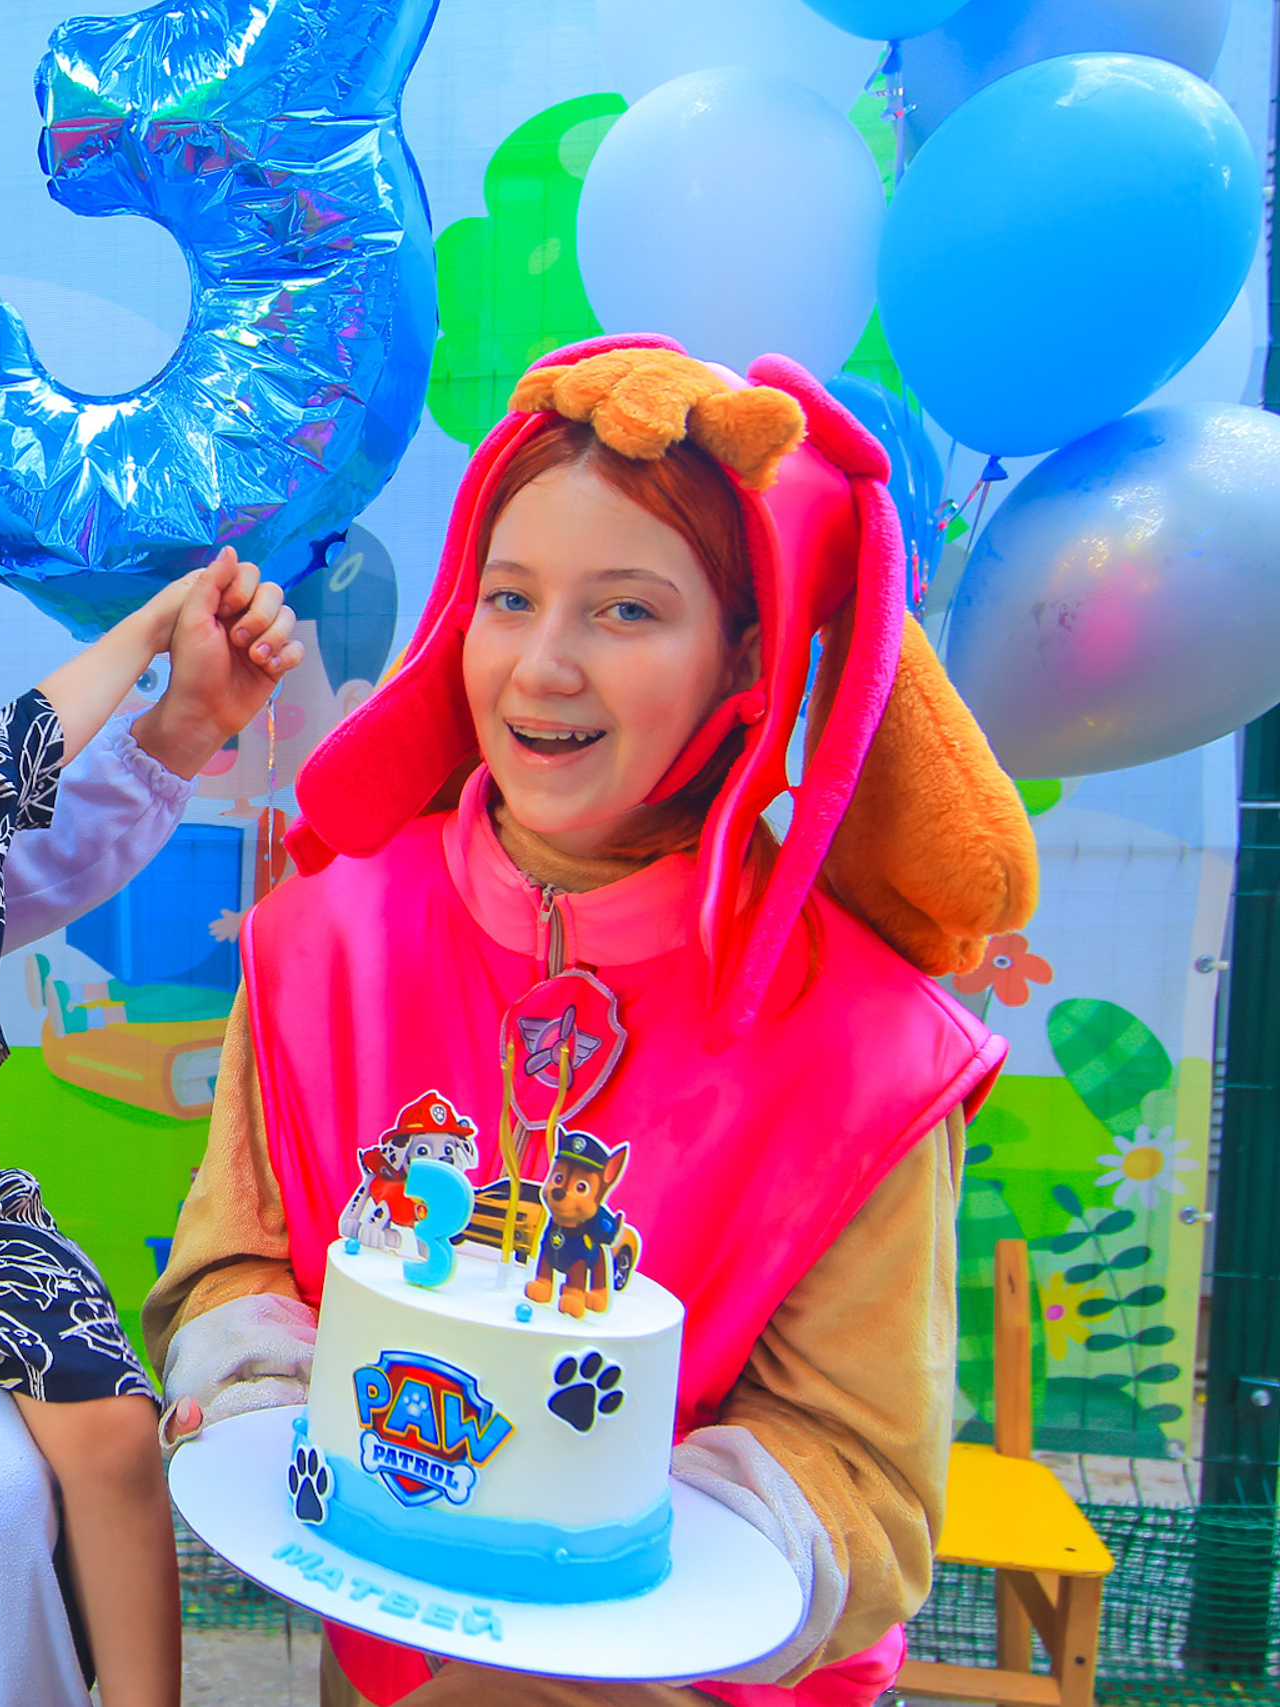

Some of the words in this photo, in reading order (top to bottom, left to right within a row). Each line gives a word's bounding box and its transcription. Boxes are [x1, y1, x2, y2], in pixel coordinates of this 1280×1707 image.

[403, 1158, 475, 1288] 3
[352, 1366, 517, 1469] PAW
[372, 1444, 459, 1490] PATROL
[271, 1541, 503, 1642] МАТВЕЙ
